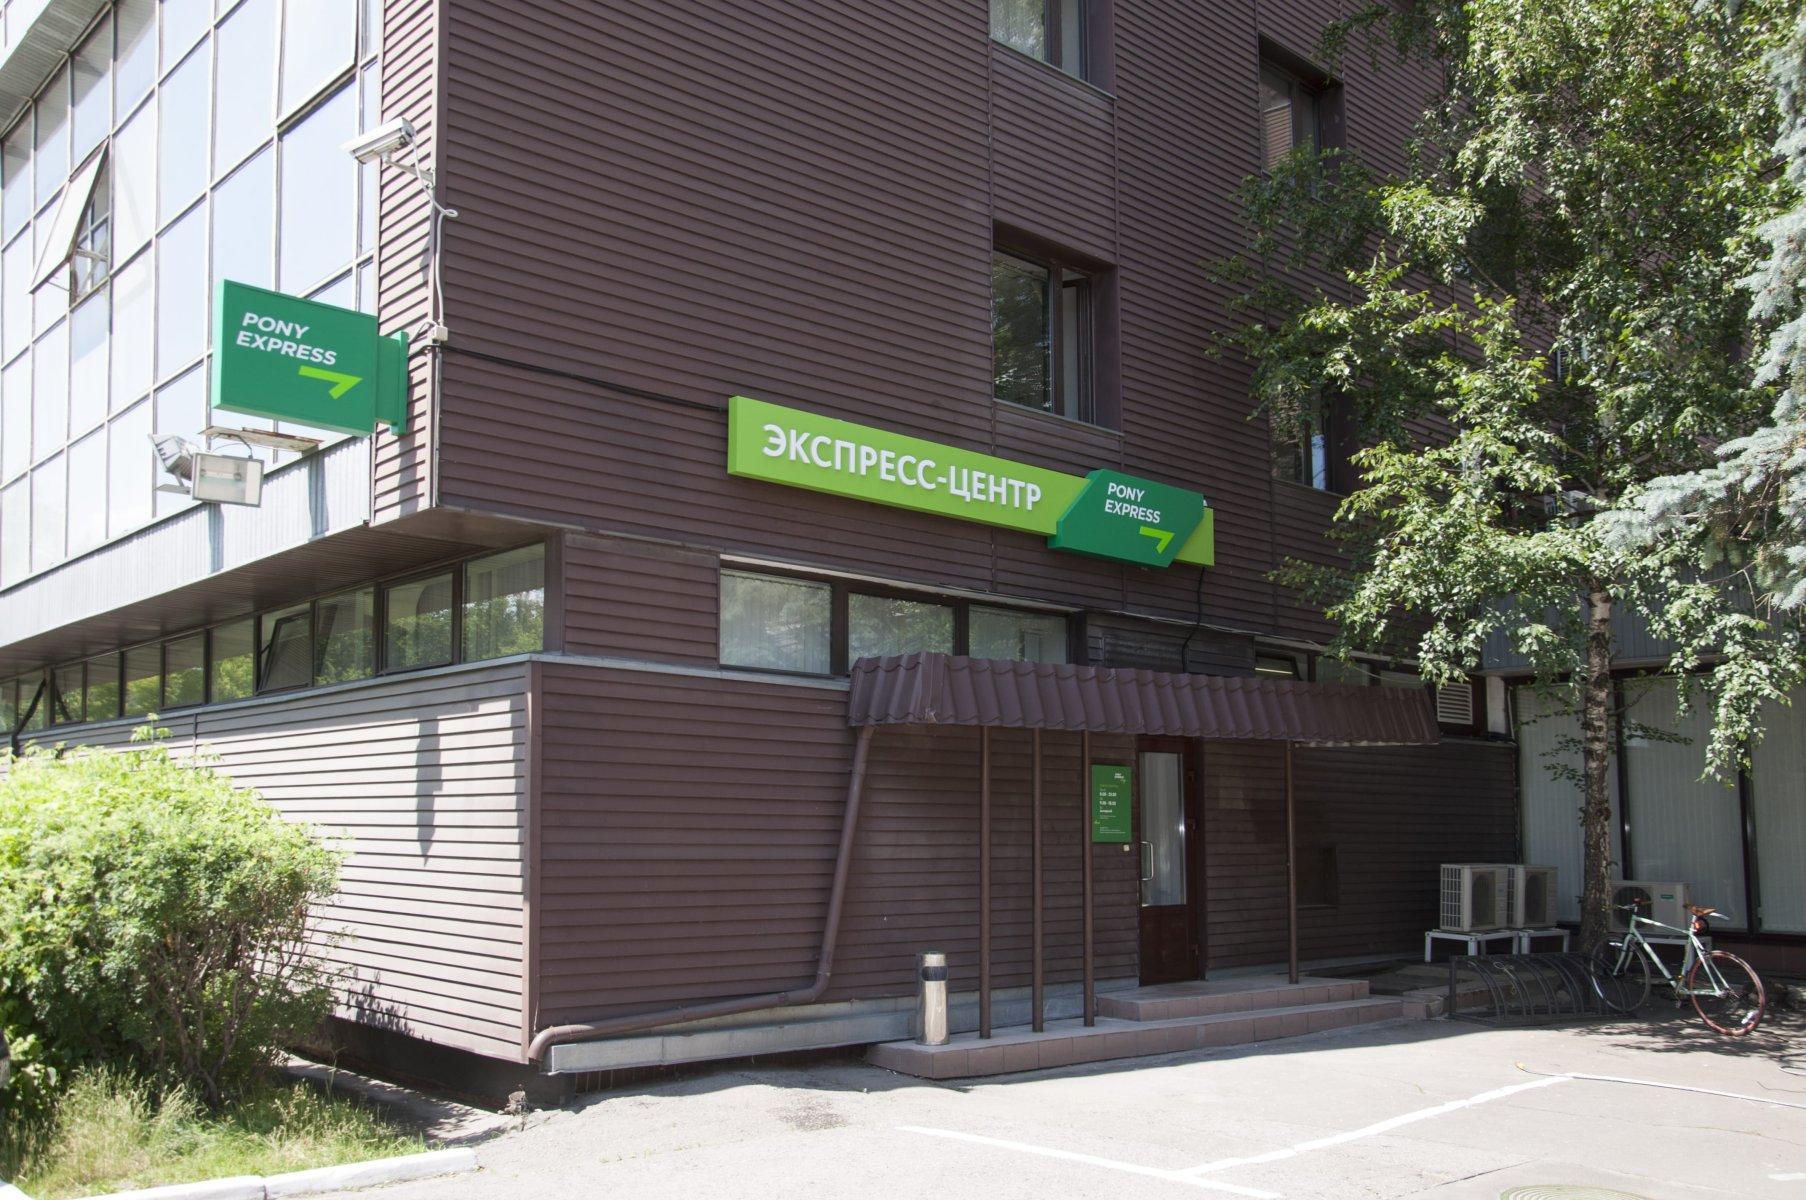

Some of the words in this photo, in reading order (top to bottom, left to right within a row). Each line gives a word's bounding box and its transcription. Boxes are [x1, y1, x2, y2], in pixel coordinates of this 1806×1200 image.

[242, 312, 310, 339] PONY
[236, 330, 338, 366] EXPRESS
[762, 423, 1042, 511] ЭКСПРЕСС-ЦЕНТР
[1107, 482, 1146, 502] PONY
[1104, 499, 1161, 524] EXPRESS
